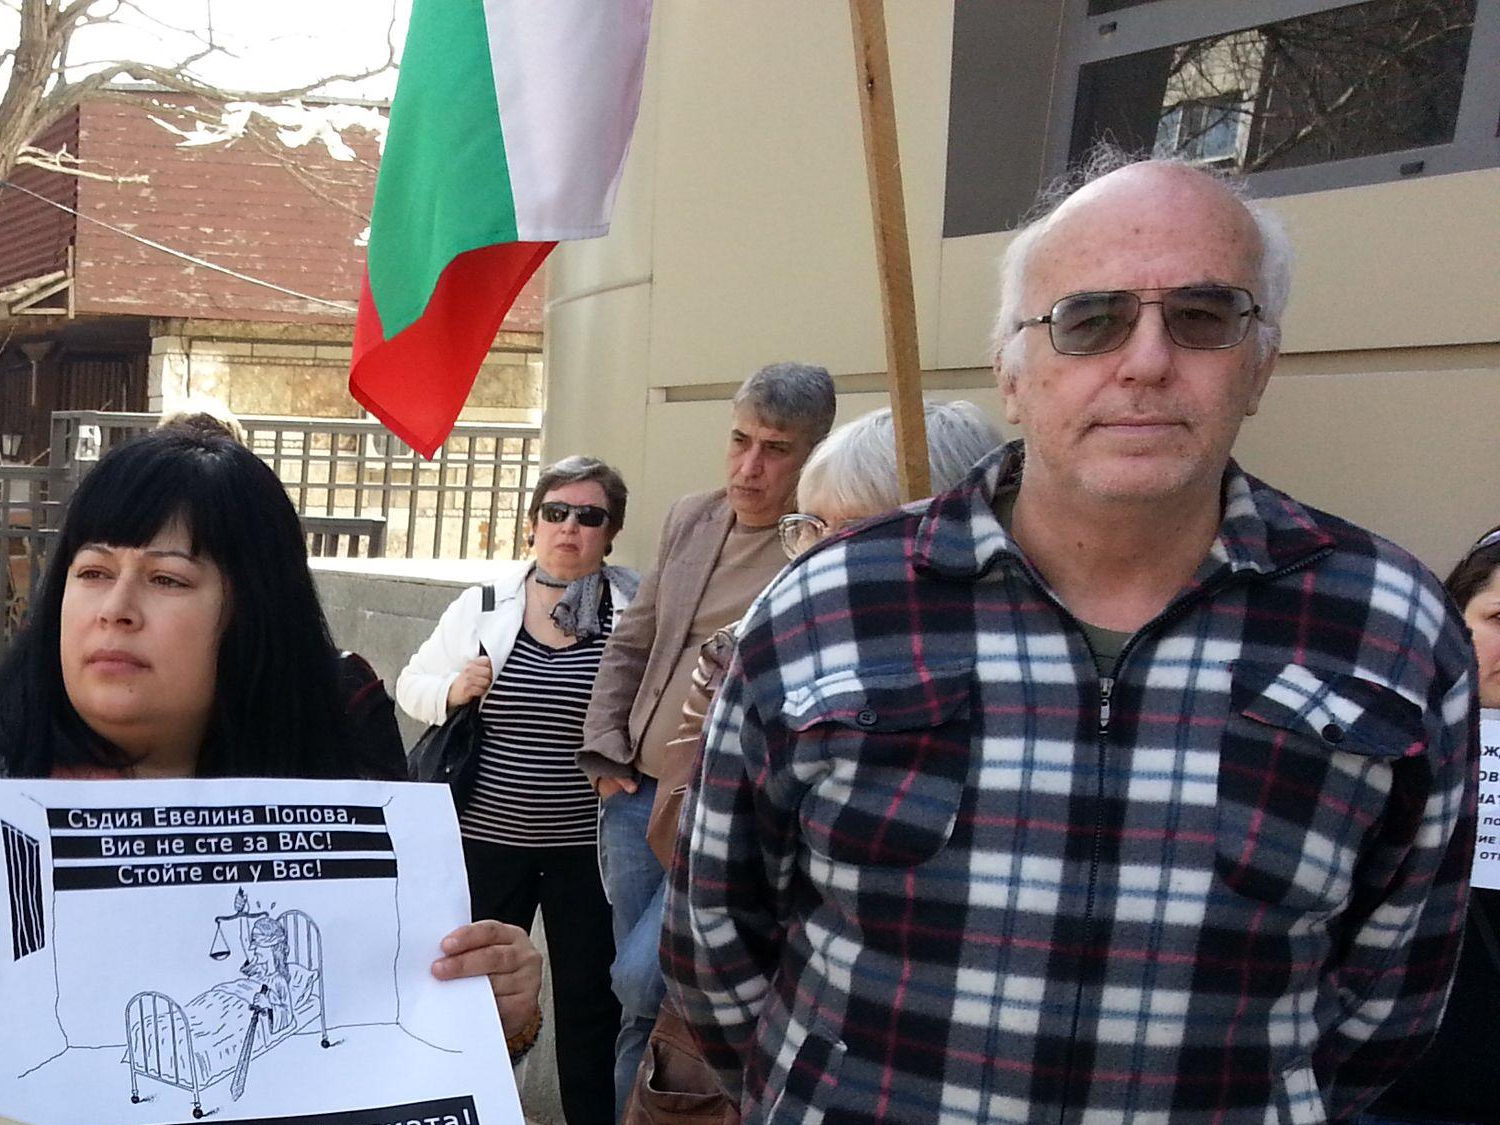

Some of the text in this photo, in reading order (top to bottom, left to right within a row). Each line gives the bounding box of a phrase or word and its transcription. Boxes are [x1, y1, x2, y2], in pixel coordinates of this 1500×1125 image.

[67, 805, 358, 829] Съдия Евелина Попова,
[100, 832, 333, 857] Вие не сте за ВАС!
[117, 858, 323, 884] Стойте си у Вас!
